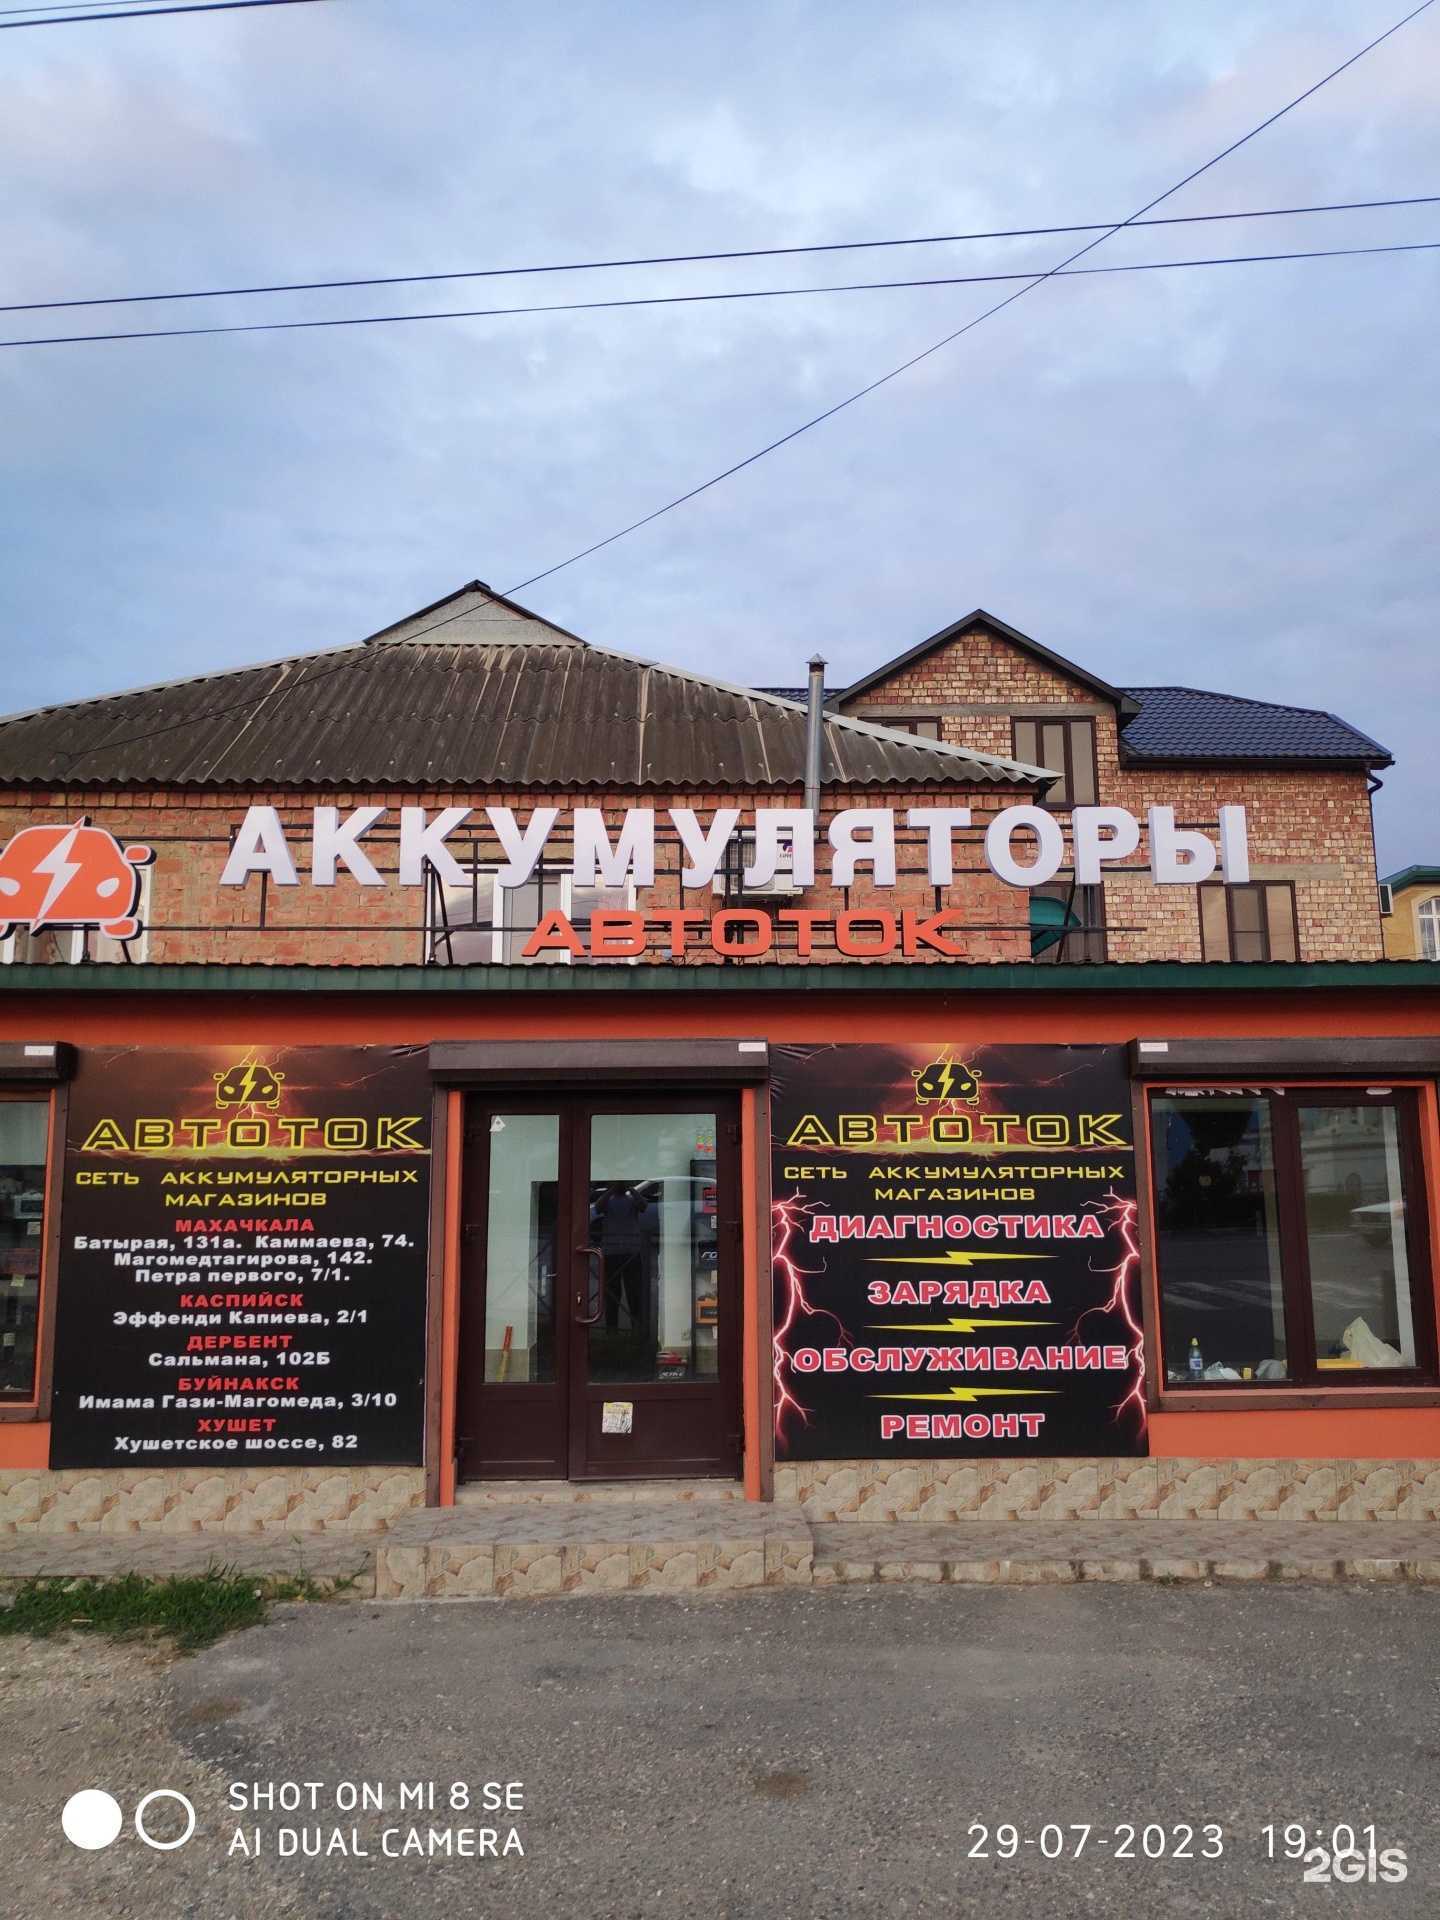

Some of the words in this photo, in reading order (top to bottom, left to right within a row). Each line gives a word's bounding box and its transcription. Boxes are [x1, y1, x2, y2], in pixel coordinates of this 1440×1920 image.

[219, 805, 1250, 888] АККУМУЛЯТОРЫ
[521, 908, 967, 958] АВТОТОК
[81, 1117, 424, 1150] АВТОТОК
[786, 1113, 1127, 1146] АВТОТОК
[75, 1171, 140, 1185] СЕТЬ
[160, 1170, 419, 1185] АККУМУЛЯТОРНЫХ
[784, 1166, 848, 1179] СЕТЬ
[868, 1165, 1125, 1180] АККУМУЛЯТОРНЫХ
[165, 1193, 327, 1207] МАГАЗИНОВ
[875, 1187, 1036, 1201] МАГАЗИНОВ
[175, 1218, 315, 1232] МАХАЧКАЛА
[809, 1214, 1105, 1243] ДИАГНОСТИКА
[73, 1235, 176, 1251] Батырая,
[183, 1236, 242, 1249] 131а.
[255, 1235, 375, 1250] Каммаева,
[382, 1234, 415, 1248] 74.
[114, 1252, 319, 1268] Магомедтагирова,
[327, 1251, 373, 1265] 142.
[135, 1269, 201, 1284] Петра
[207, 1270, 304, 1284] первого,
[311, 1268, 350, 1282] 7/1.
[180, 1291, 304, 1308] КАСПИЙСК
[867, 1280, 1052, 1308] ЗАРЯДКА
[112, 1311, 222, 1328] Эффенди
[229, 1311, 330, 1326] Капиева,
[337, 1310, 368, 1324] 2/1
[187, 1335, 293, 1351] ДЕРБЕНТ
[148, 1352, 269, 1368] Сальмана,
[276, 1352, 331, 1366] 102Б
[793, 1346, 1127, 1372] ОБСЛУЖИВАНИЕ
[178, 1375, 300, 1392] БУЙНАКСК
[78, 1395, 155, 1410] Имама
[161, 1394, 344, 1410] Гази-Магомеда,
[351, 1393, 397, 1407] 3/10
[197, 1418, 277, 1433] ХУШЕТ
[880, 1413, 1045, 1439] РЕМОНТ
[114, 1437, 239, 1453] Хушетское
[245, 1437, 325, 1452] шоссе,
[331, 1435, 359, 1449] 82
